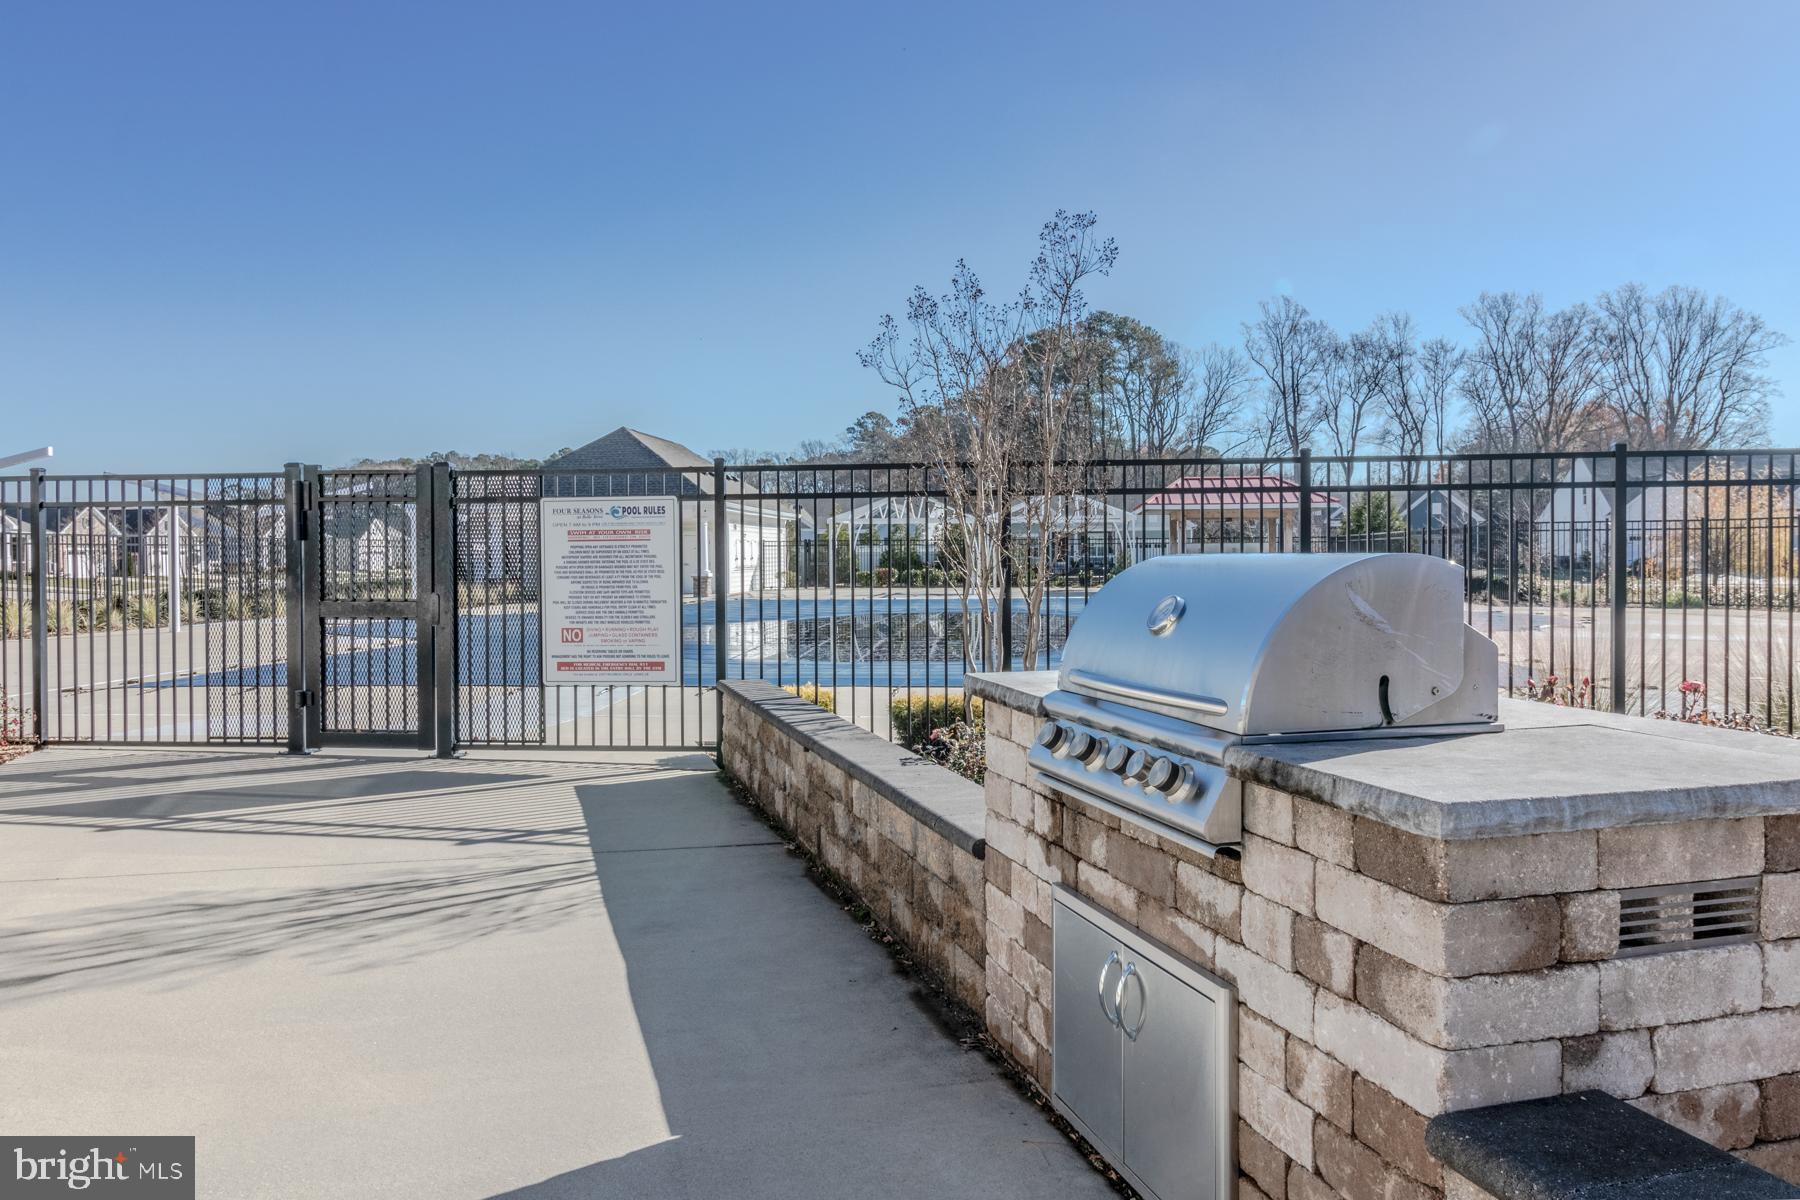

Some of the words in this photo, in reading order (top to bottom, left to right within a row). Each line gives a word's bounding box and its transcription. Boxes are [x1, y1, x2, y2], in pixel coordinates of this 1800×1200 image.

[622, 506, 641, 515] POOL
[643, 505, 666, 515] RULES
[563, 629, 582, 641] NO
